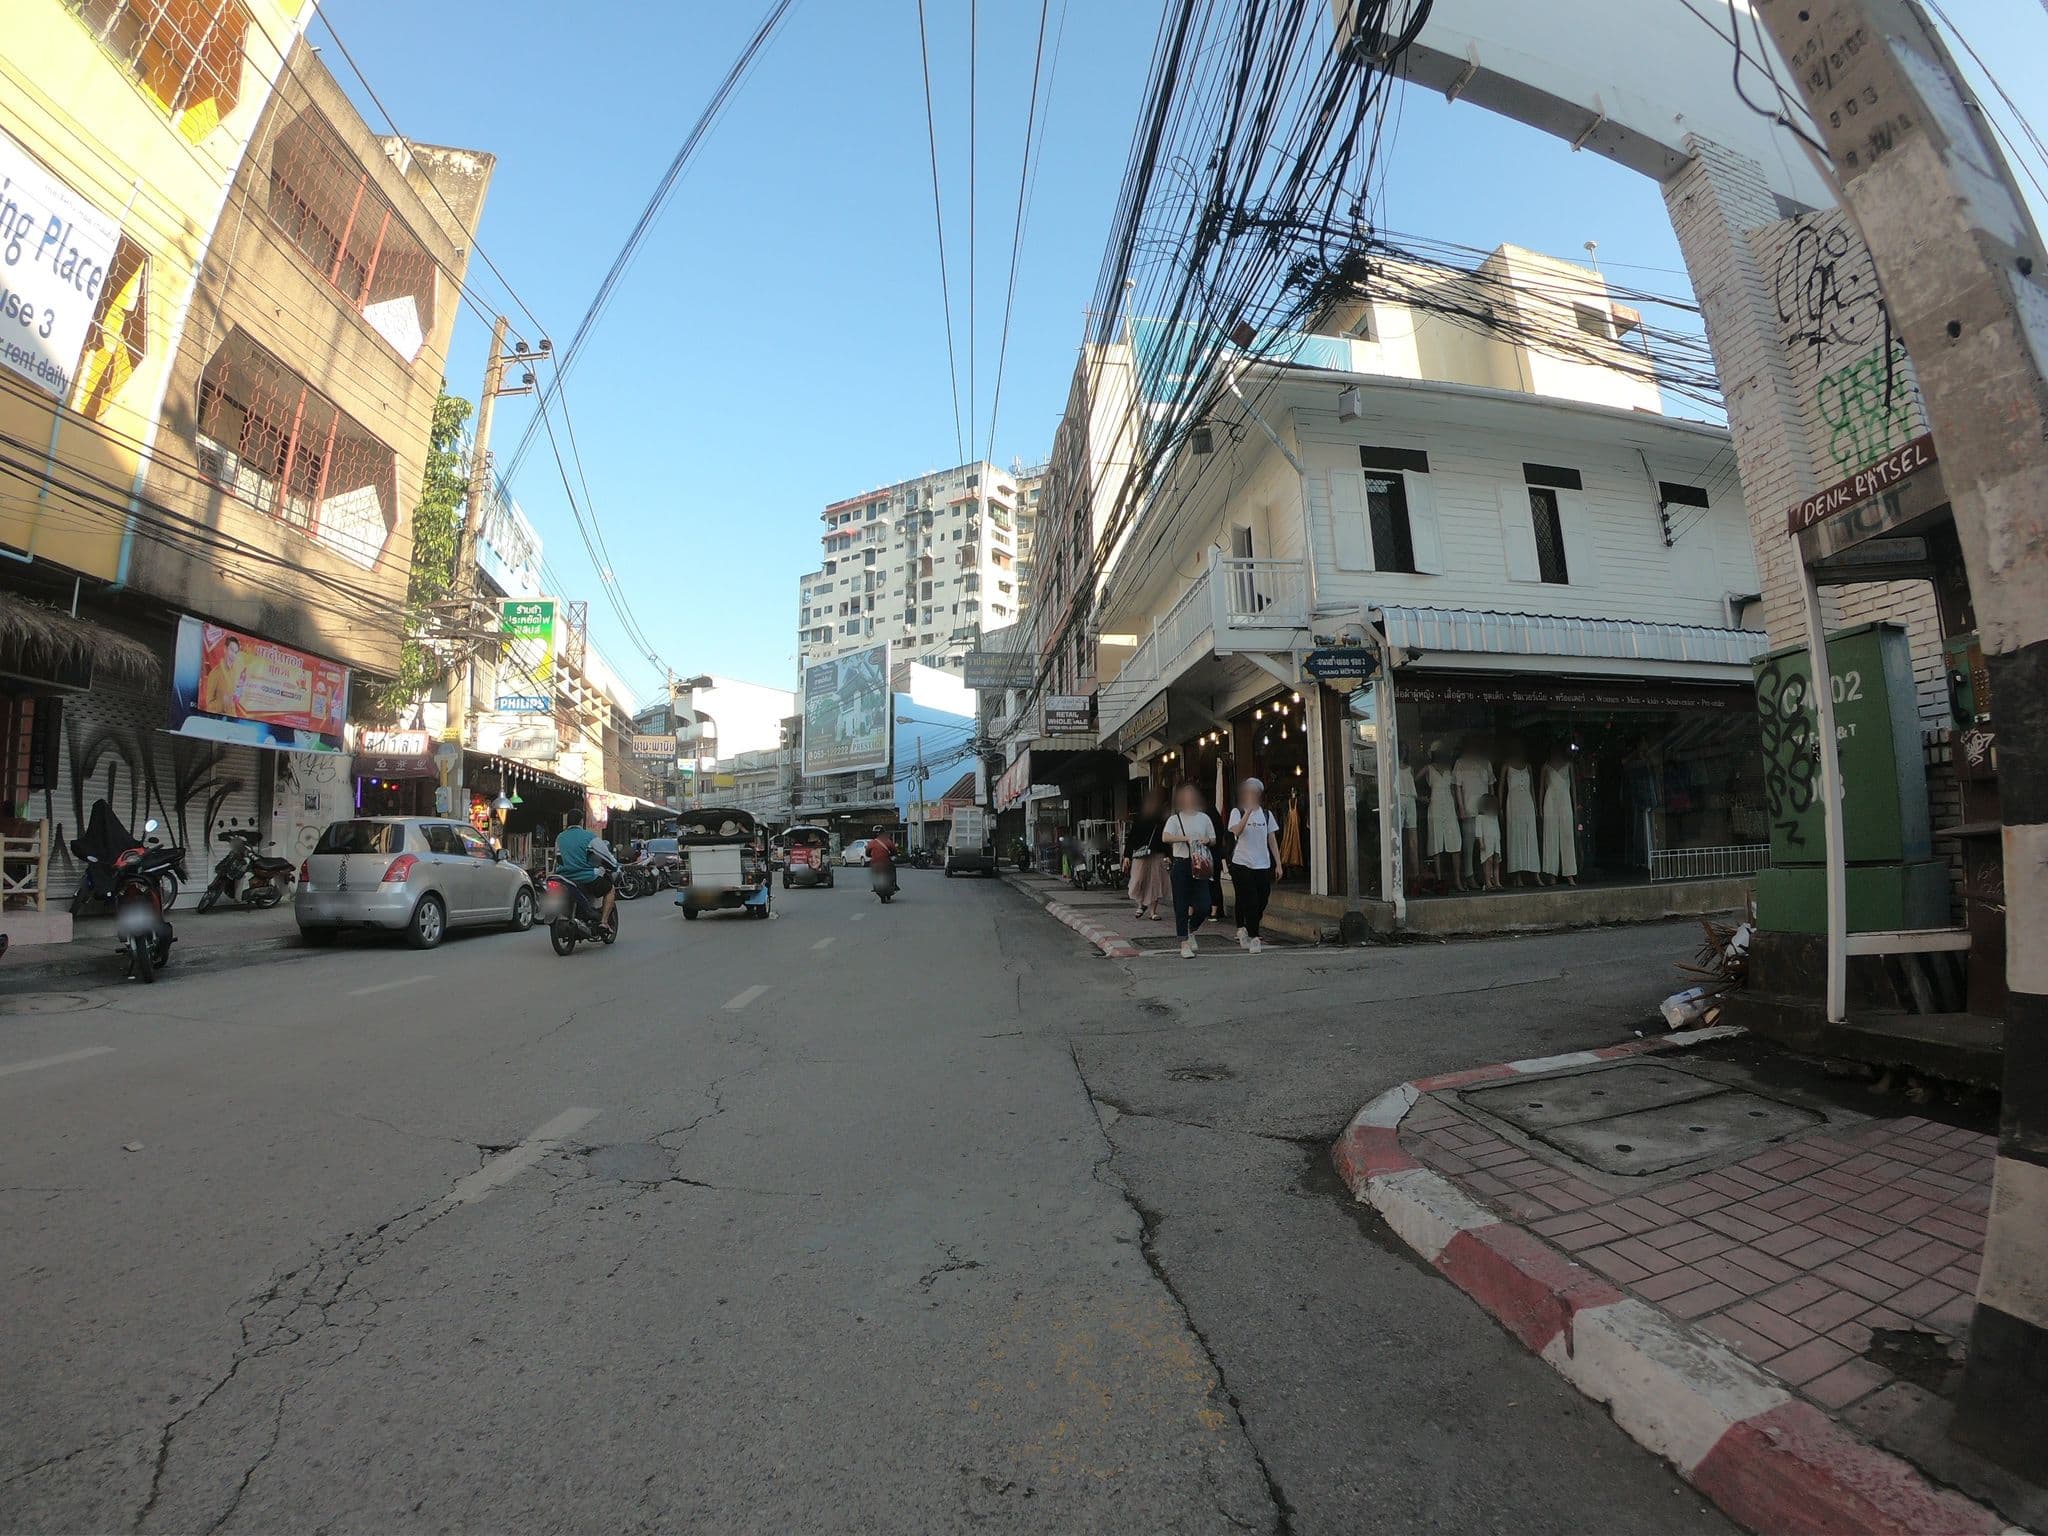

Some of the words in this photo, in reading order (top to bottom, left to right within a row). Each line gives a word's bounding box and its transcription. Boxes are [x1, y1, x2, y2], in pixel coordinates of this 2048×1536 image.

[34, 213, 103, 301] Place
[38, 308, 55, 339] 3
[5, 340, 36, 373] rent
[37, 357, 69, 395] daily
[500, 698, 545, 710] PHILIPS
